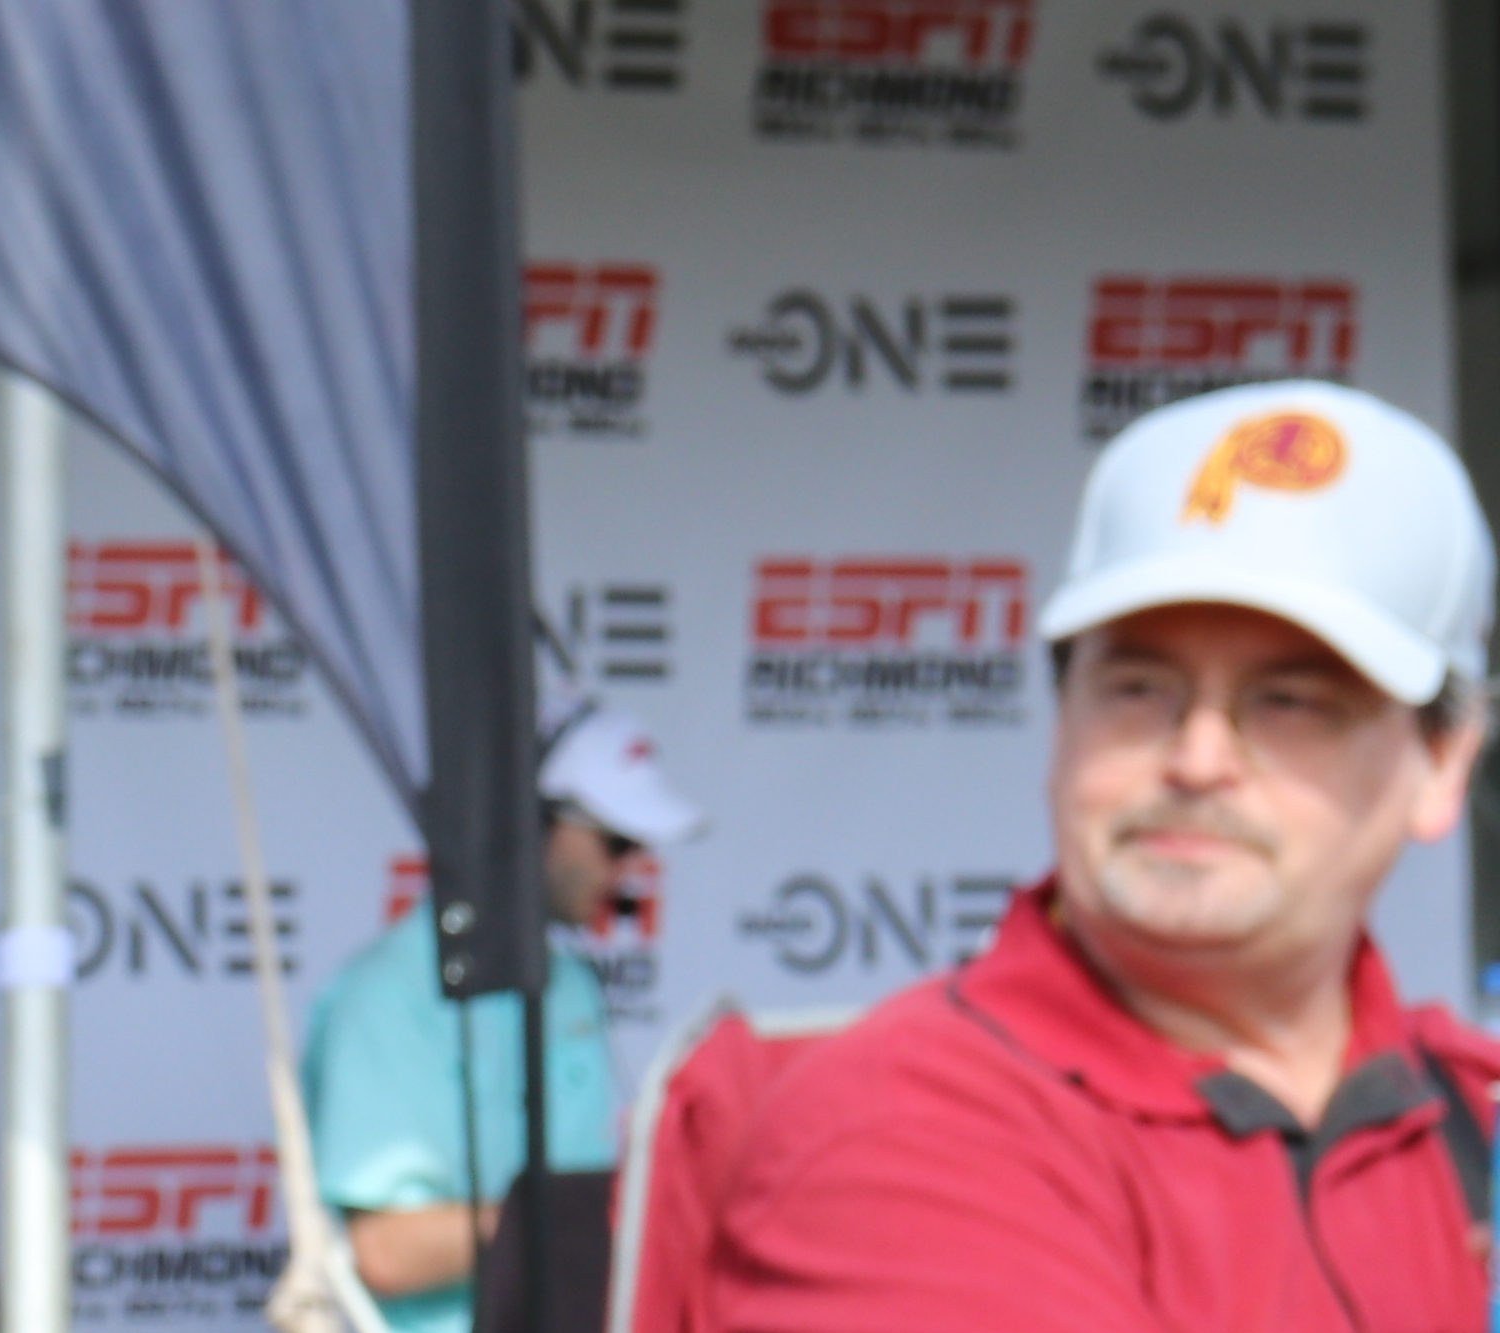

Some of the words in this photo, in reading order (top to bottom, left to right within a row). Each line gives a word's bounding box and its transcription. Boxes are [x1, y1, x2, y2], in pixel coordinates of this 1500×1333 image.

[510, 0, 684, 91] NE
[523, 263, 657, 356] PN
[1090, 278, 1355, 370] ESPN
[67, 544, 262, 630] SP
[536, 587, 668, 677] NE
[754, 560, 1025, 643] ESPN
[70, 1146, 280, 1232] SP
